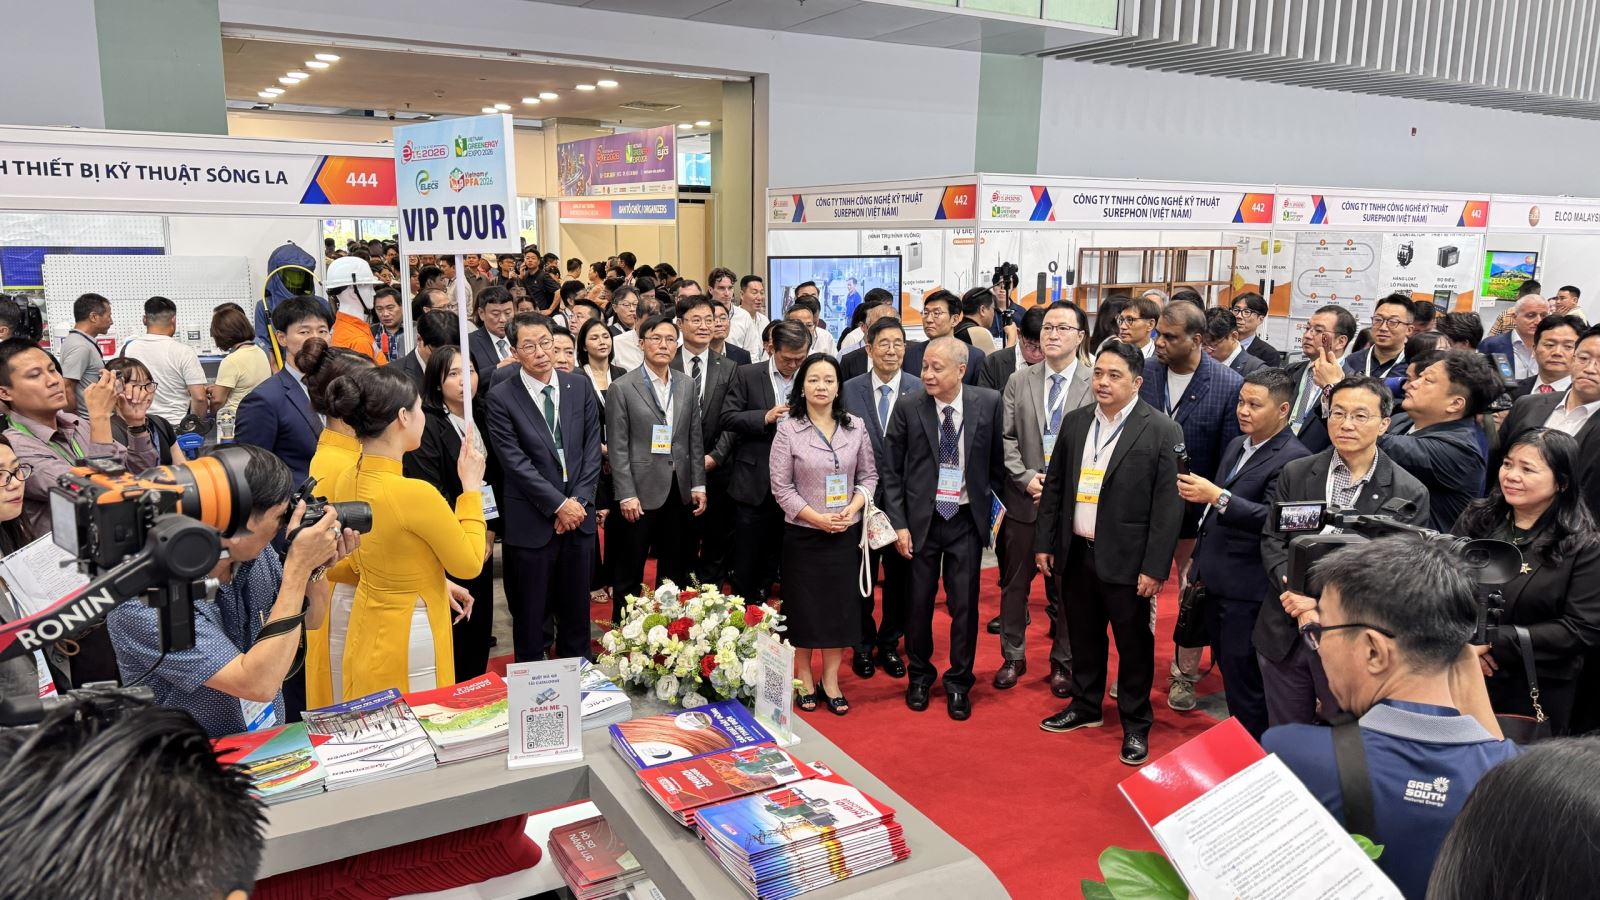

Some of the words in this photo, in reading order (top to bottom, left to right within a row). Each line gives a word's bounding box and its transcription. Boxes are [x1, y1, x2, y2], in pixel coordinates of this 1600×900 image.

[468, 140, 499, 150] GREENERGY
[12, 157, 74, 177] THIẾT
[80, 163, 100, 182] BỊ
[105, 162, 131, 179] KỸ
[135, 164, 201, 186] THUẬT
[206, 166, 260, 184] SÔNG
[265, 170, 288, 185] LA
[345, 172, 378, 188] 444
[420, 182, 438, 190] ELECS
[816, 197, 830, 206] CÔNG
[832, 198, 839, 206] TY
[840, 197, 855, 206] TNHH
[856, 195, 872, 206] CÔNG
[874, 194, 890, 206] NGHỆ
[901, 192, 923, 205] THUẬT
[954, 194, 968, 206] 442
[1073, 192, 1098, 204] CÔNG
[1099, 195, 1110, 204] TY
[1111, 196, 1134, 205] TNHH
[1136, 194, 1160, 206] CÔNG
[1161, 196, 1182, 208] NGHỆ
[1196, 197, 1220, 208] THUẬT
[643, 204, 668, 214] ORGANIZERS
[834, 208, 865, 218] SUREPHON
[881, 206, 899, 216] NAM)
[1103, 208, 1148, 218] SUREPHON
[1171, 208, 1192, 218] NAM)
[1252, 203, 1266, 212] 442
[1342, 201, 1360, 210] CÔNG
[1370, 203, 1386, 211] TNHH
[1386, 202, 1404, 212] CÔNG
[1430, 204, 1448, 215] THUẬT
[1472, 209, 1482, 218] 442
[402, 208, 438, 241] VIP
[443, 204, 507, 241] TOUR
[1362, 214, 1395, 222] SUREPHON
[1411, 214, 1428, 224] NAM)
[1555, 211, 1573, 222] ELCO
[16, 587, 114, 650] RONIN
[453, 681, 492, 696] CAPACITY
[1407, 780, 1432, 791] GAS
[1405, 788, 1446, 802] SOUTH
[833, 799, 866, 819] THIBIDI
[840, 797, 874, 816] CATALOGUE
